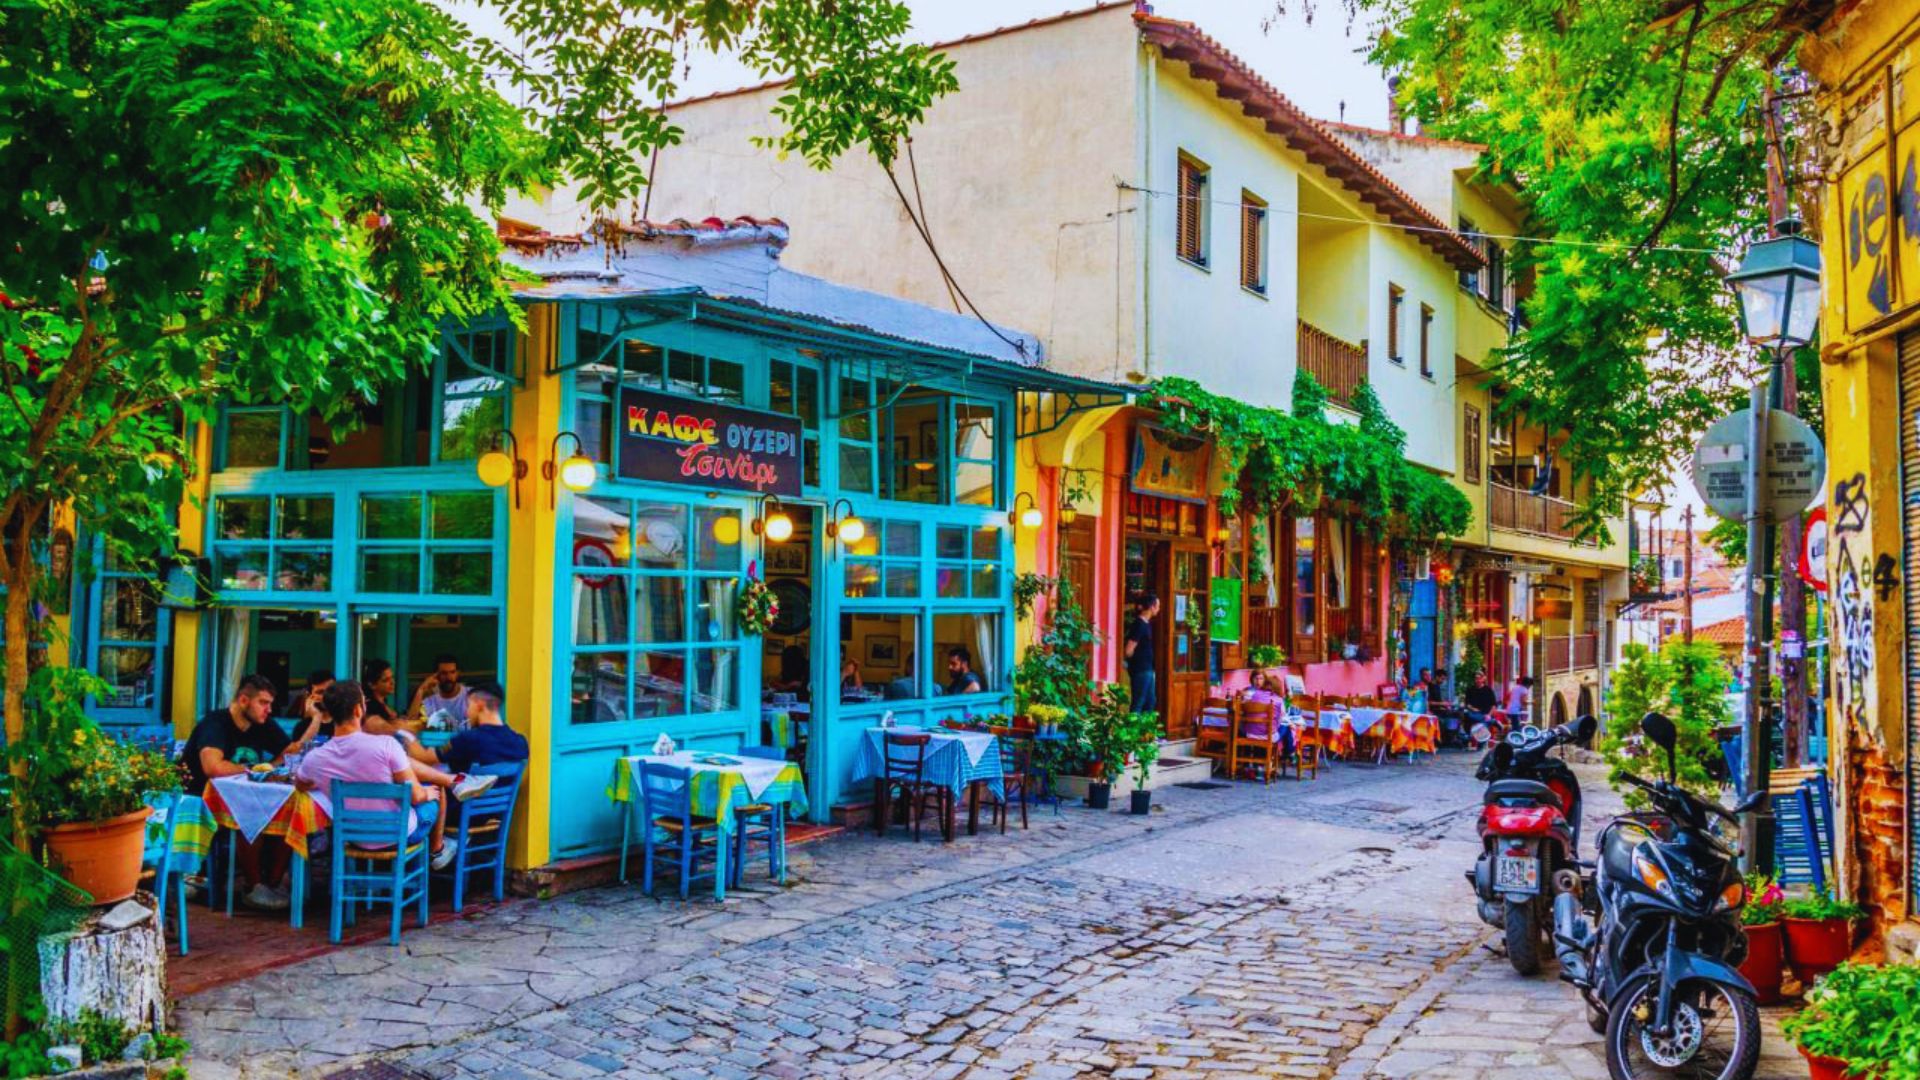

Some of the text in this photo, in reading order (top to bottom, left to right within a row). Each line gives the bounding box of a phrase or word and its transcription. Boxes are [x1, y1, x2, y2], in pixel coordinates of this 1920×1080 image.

[628, 405, 796, 457] ΚΑΦΕ ΟΥΖΕΡΙ
[676, 442, 778, 491] Τσινάρι
